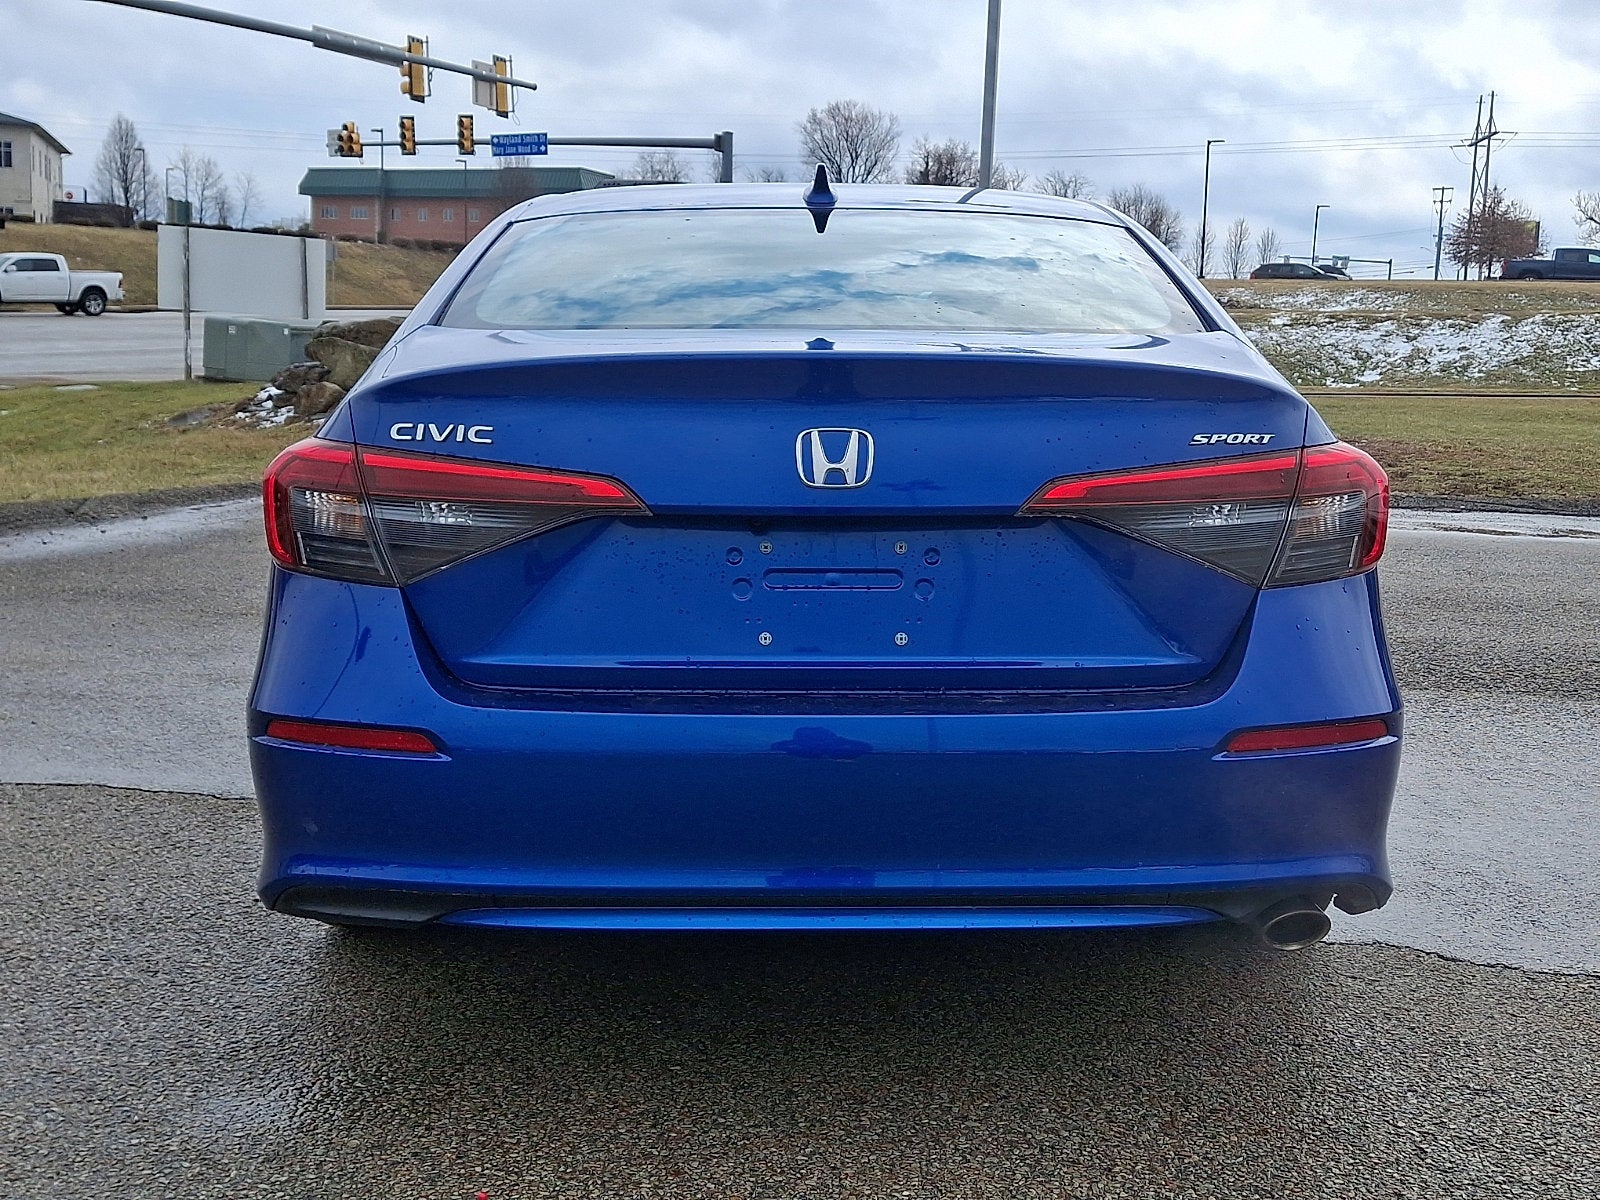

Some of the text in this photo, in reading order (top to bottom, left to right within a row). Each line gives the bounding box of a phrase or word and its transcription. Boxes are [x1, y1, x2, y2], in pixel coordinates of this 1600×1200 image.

[522, 134, 539, 143] Smith
[390, 422, 494, 444] CIVIC
[1189, 433, 1276, 445] SPORT
